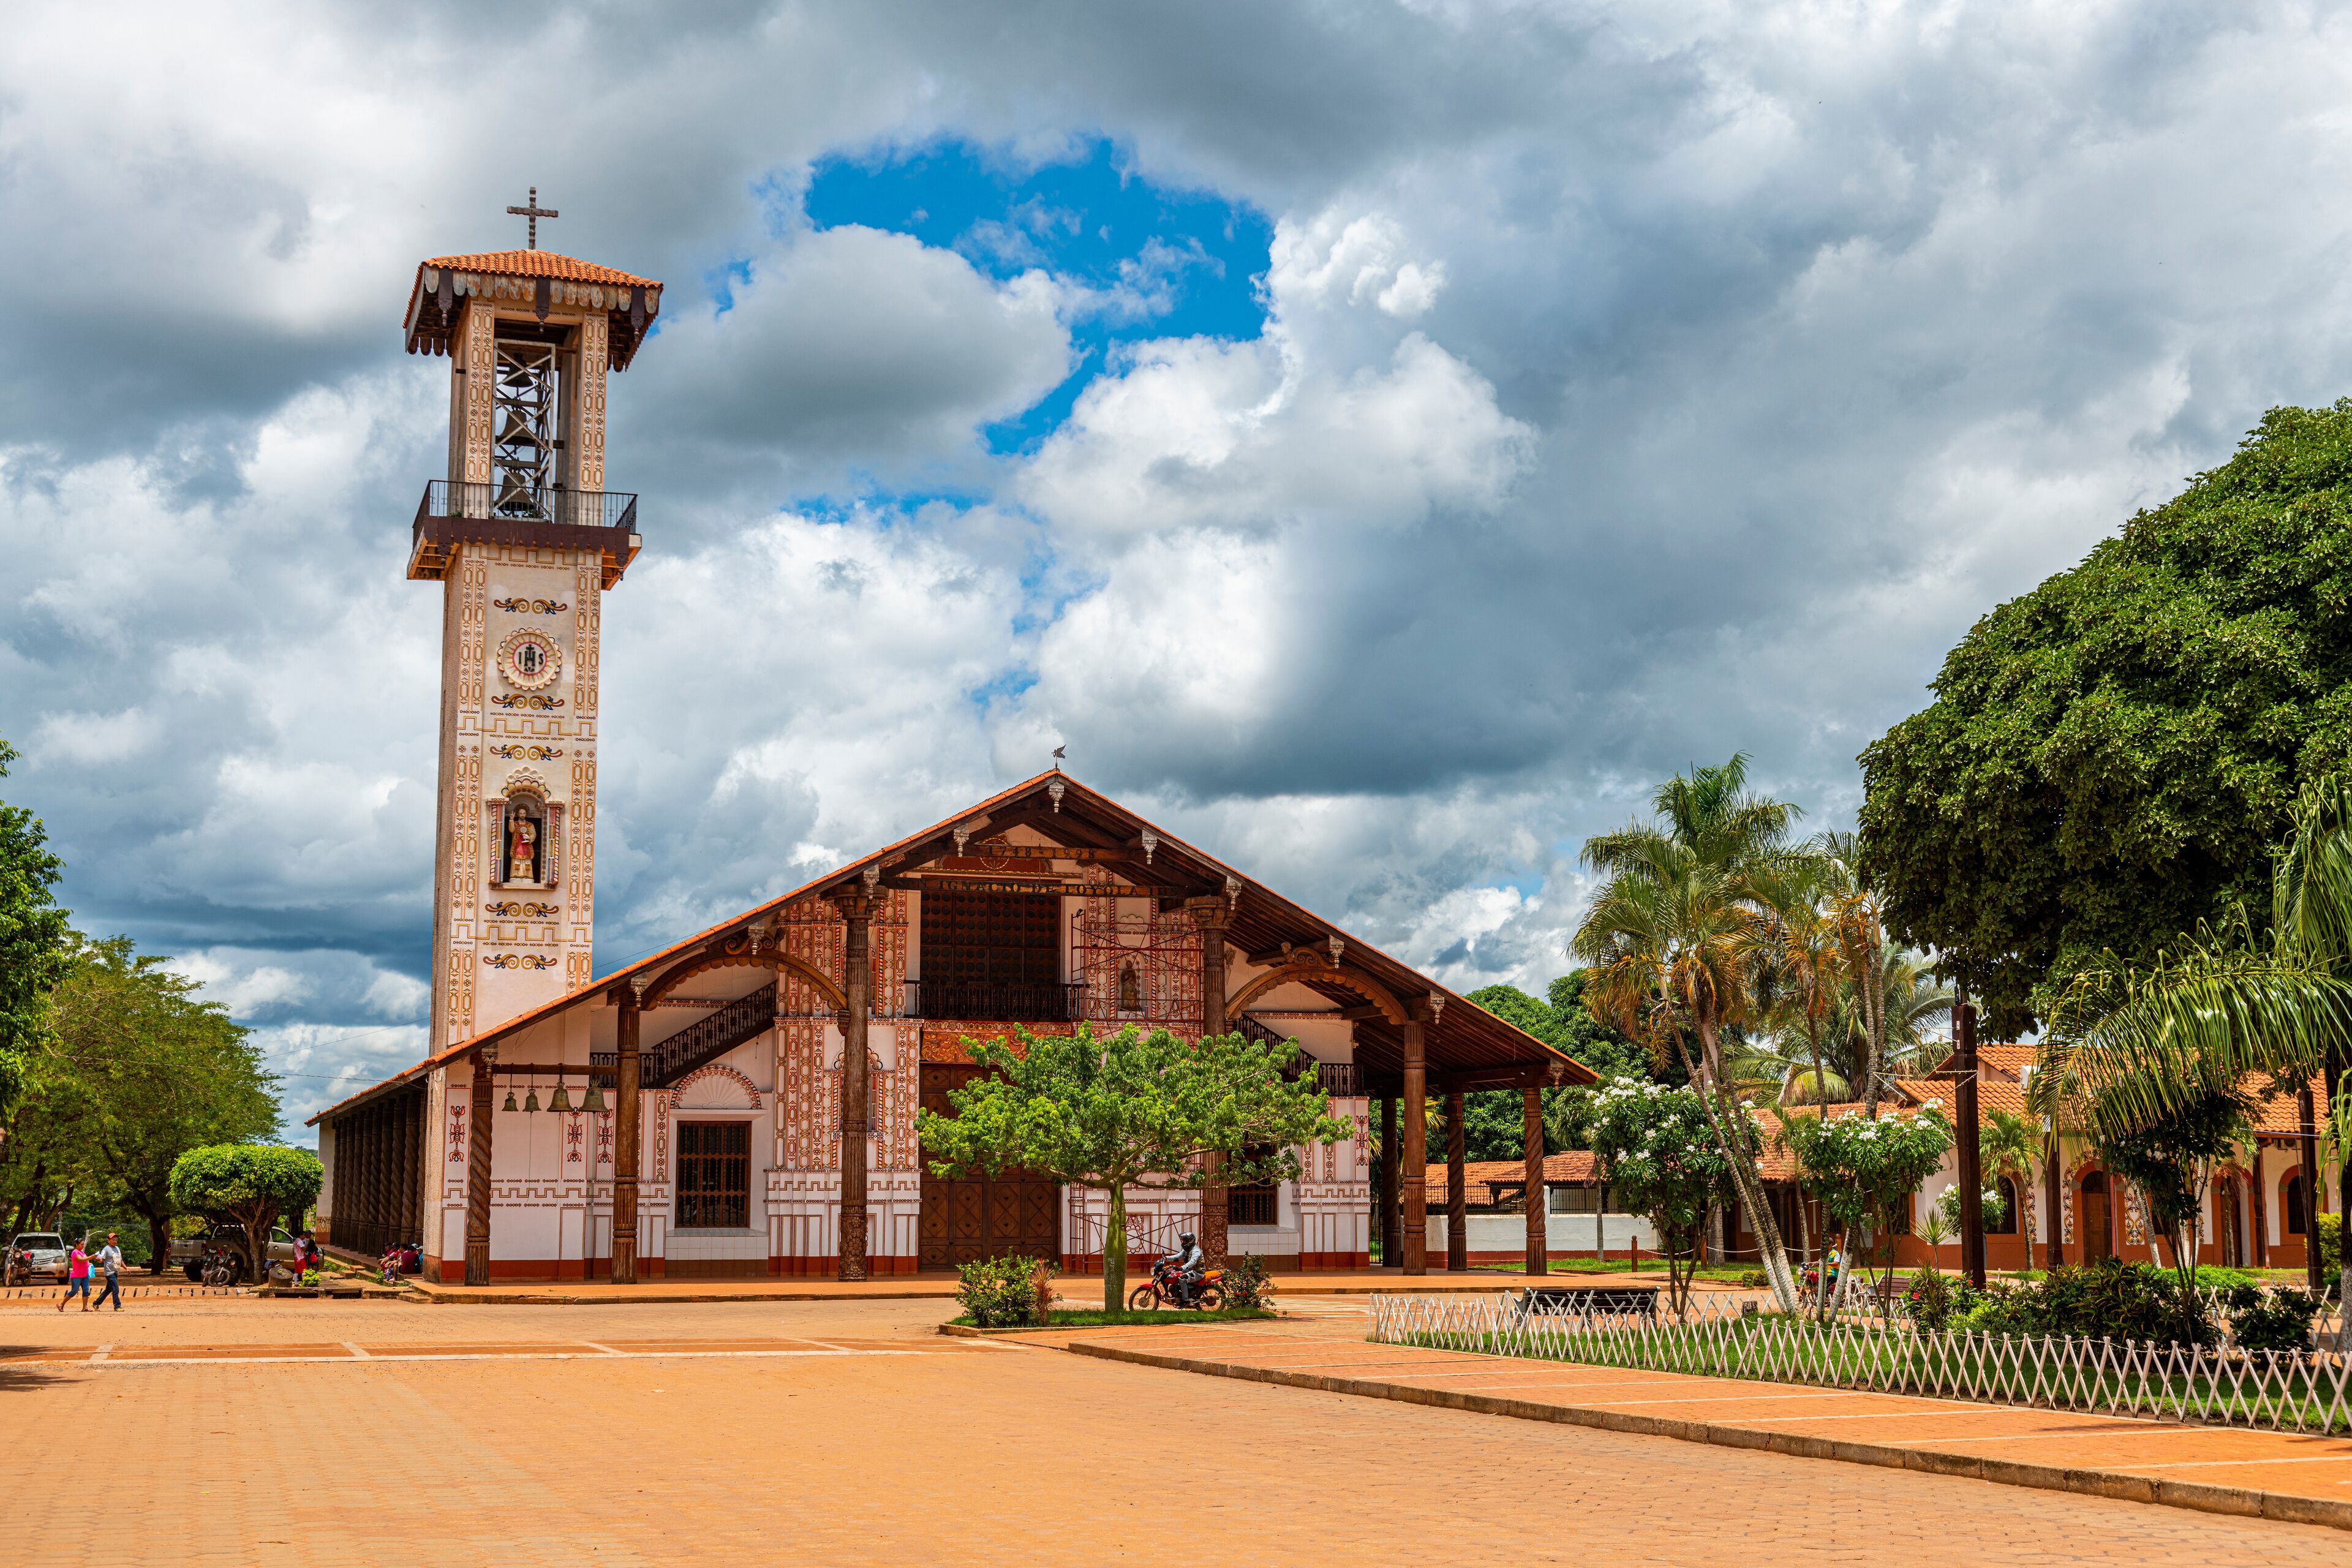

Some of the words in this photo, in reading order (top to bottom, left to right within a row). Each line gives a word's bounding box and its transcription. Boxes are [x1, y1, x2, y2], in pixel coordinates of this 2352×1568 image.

[518, 650, 544, 667] IHS
[939, 880, 1021, 892] IGNACIO
[1031, 883, 1058, 894] DE
[1065, 884, 1139, 895] LOYOLA
